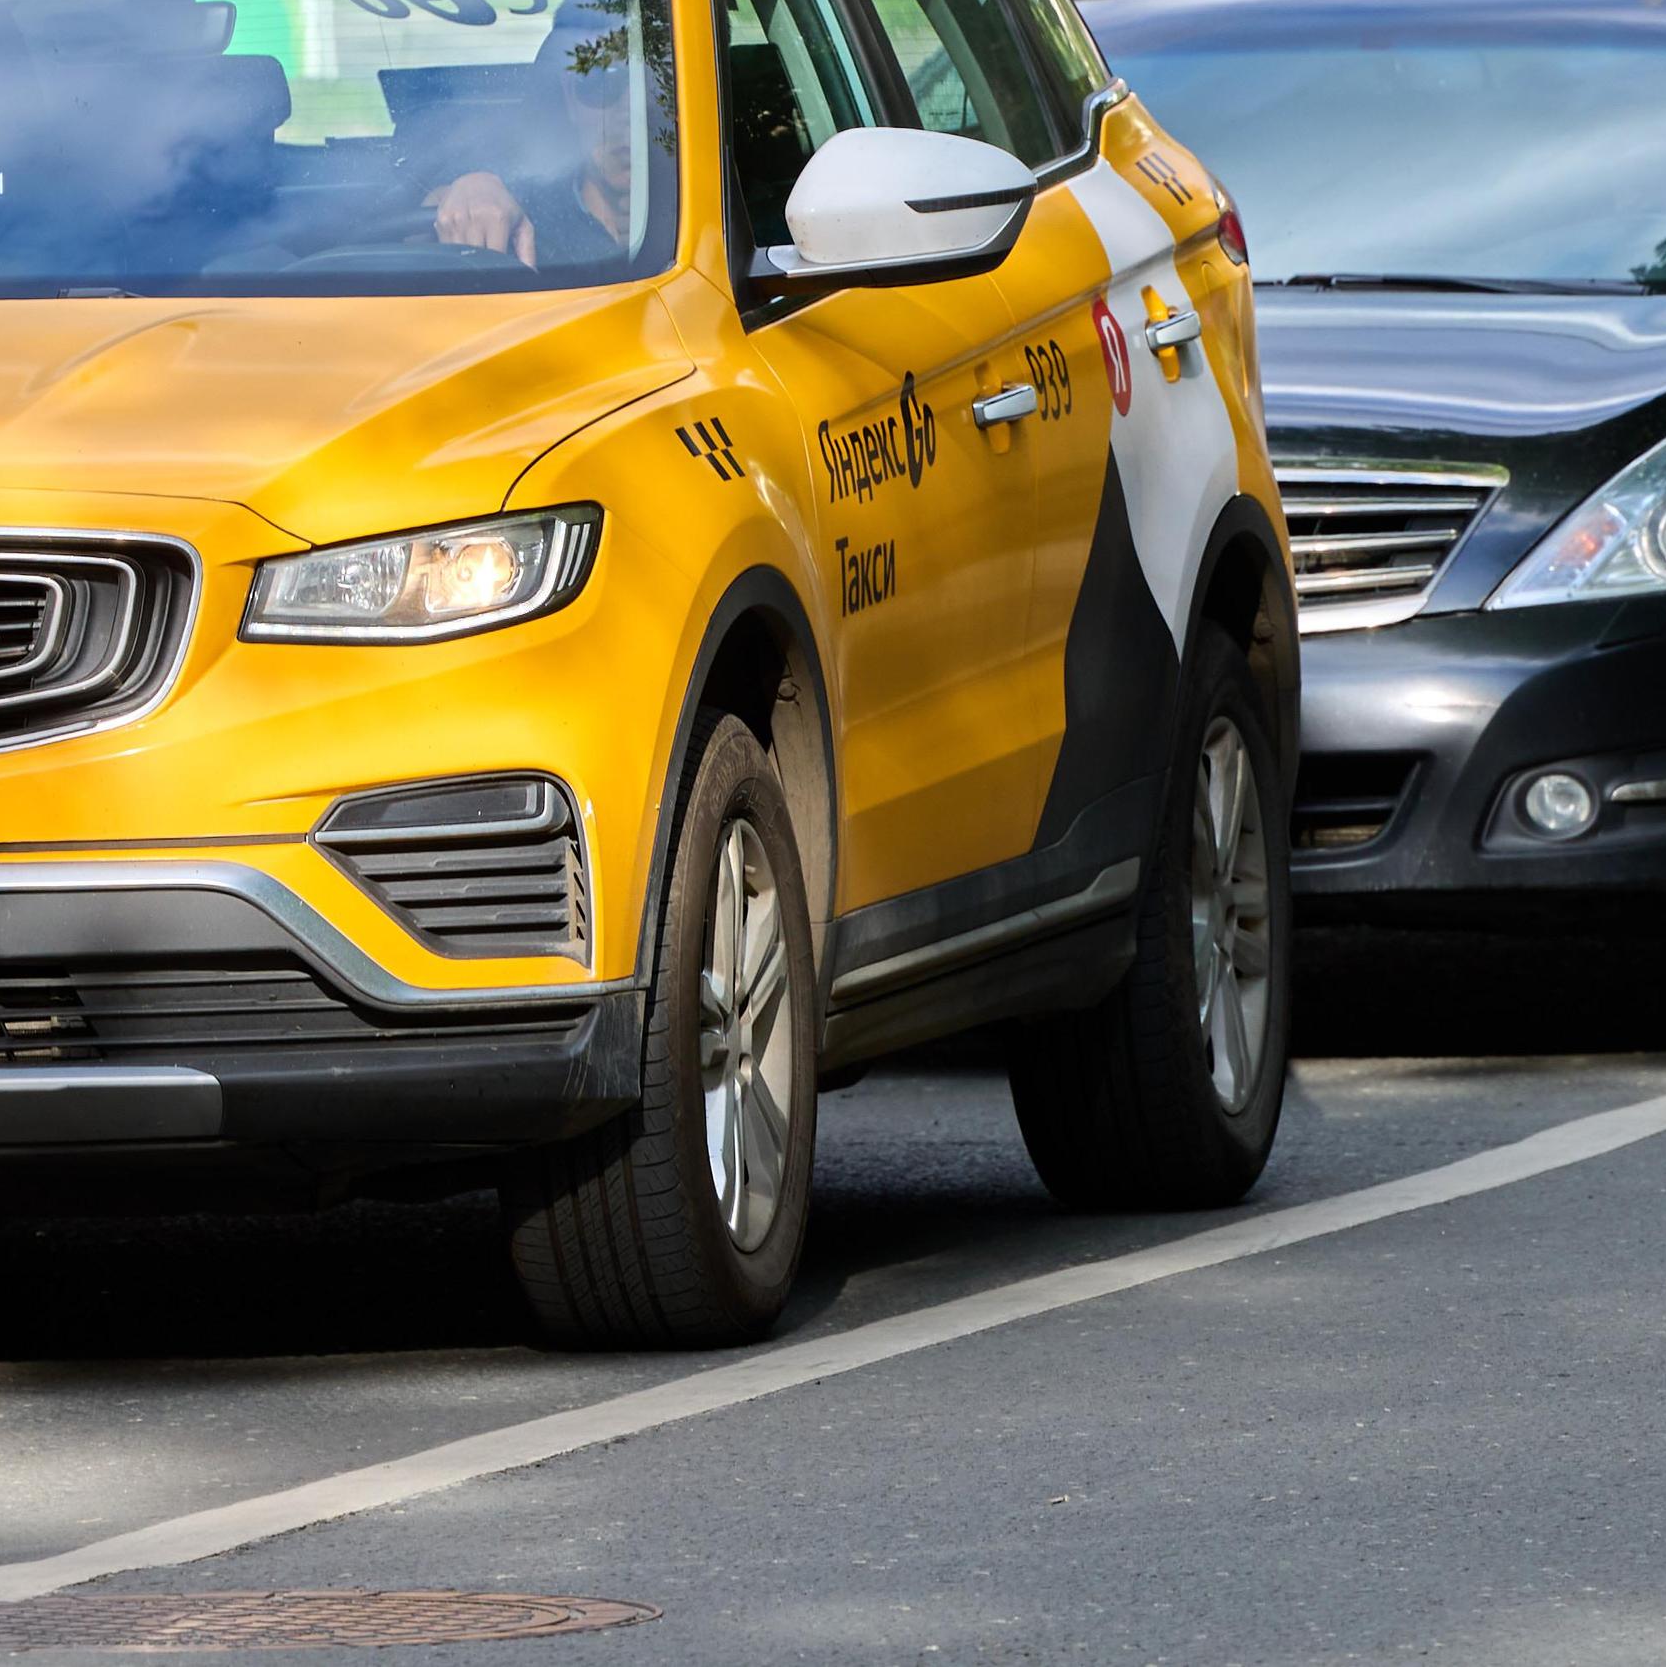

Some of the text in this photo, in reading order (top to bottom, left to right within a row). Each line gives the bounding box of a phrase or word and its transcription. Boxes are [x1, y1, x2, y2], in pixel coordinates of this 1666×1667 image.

[1024, 339, 1072, 421] 939
[1100, 315, 1127, 394] Я
[818, 370, 936, 505] Яндекс Go
[836, 536, 896, 617] Такси
